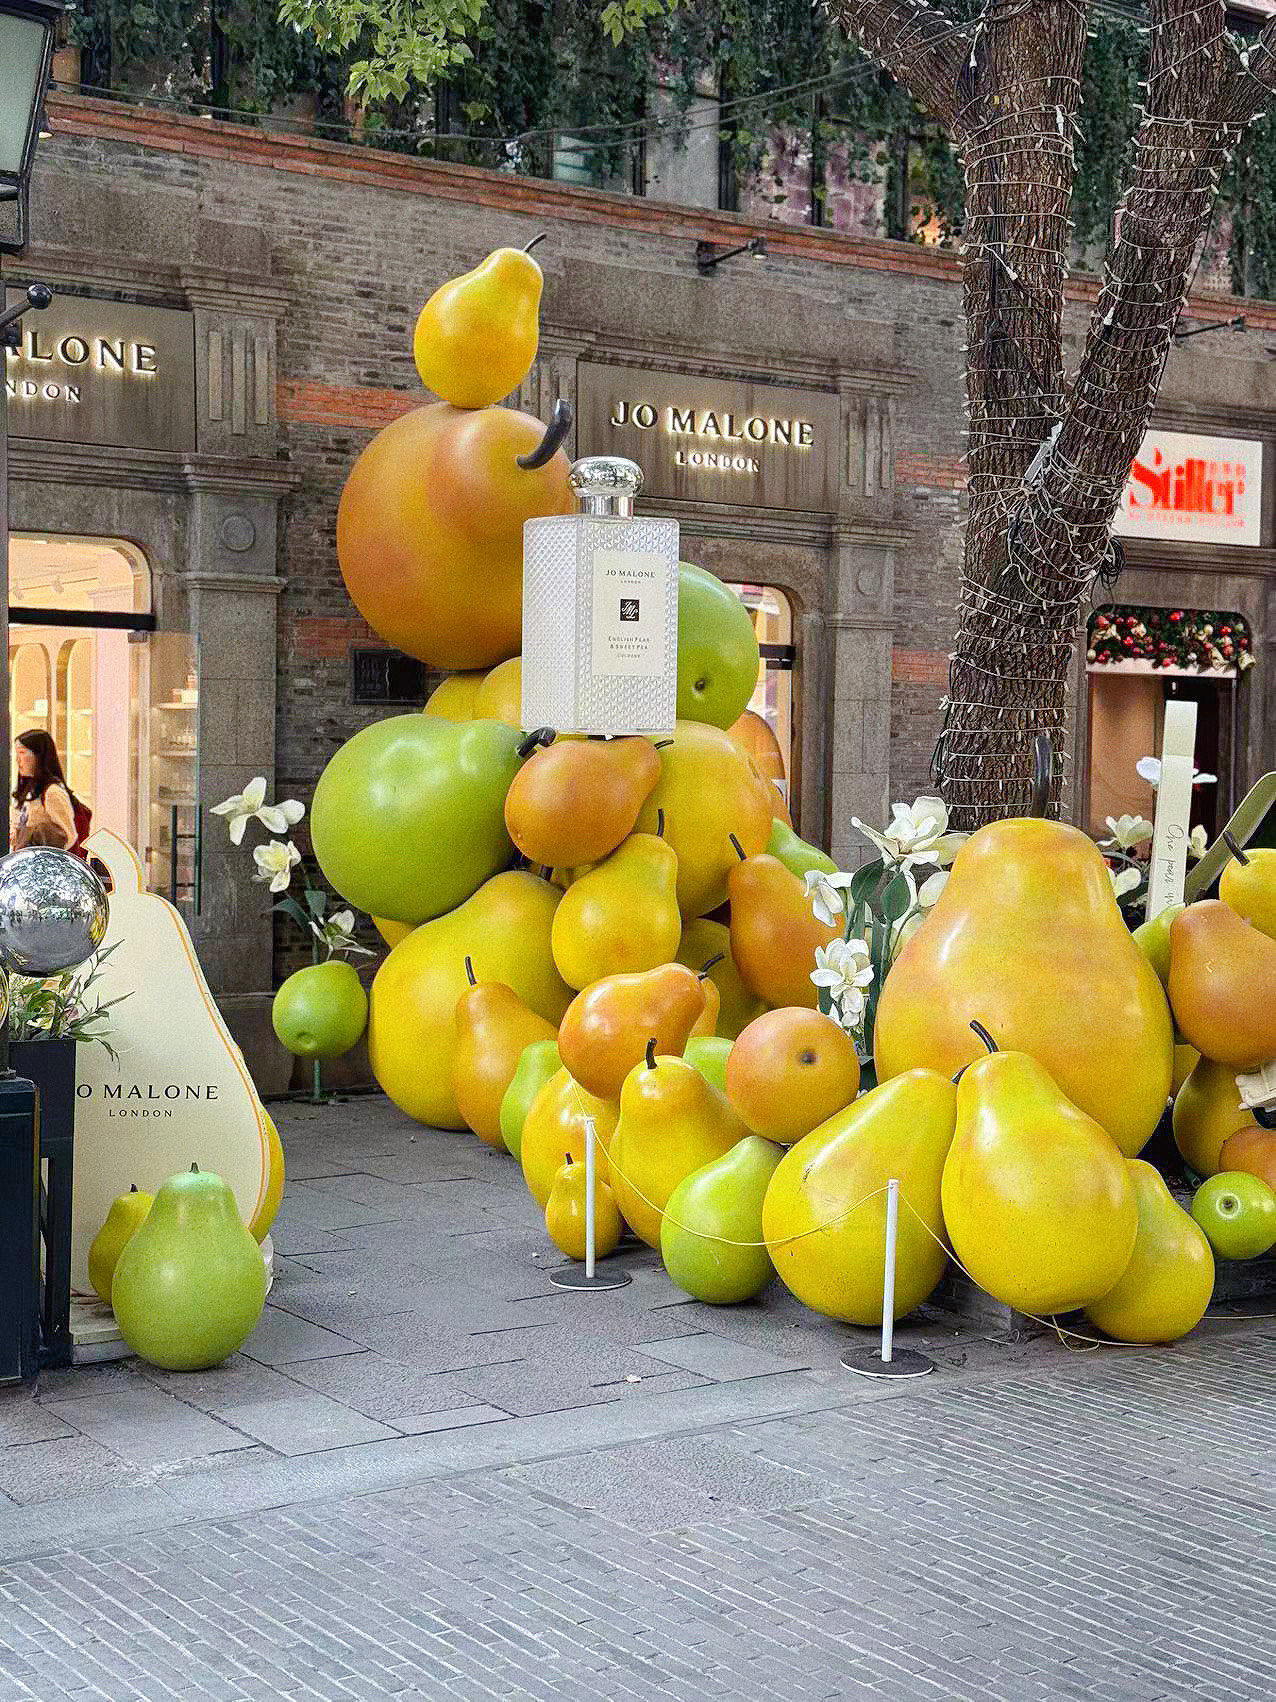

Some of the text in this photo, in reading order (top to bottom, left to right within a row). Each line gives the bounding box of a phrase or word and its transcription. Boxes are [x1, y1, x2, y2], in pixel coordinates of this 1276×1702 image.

[6, 331, 158, 374] LONE
[6, 380, 81, 402] NDON
[610, 401, 814, 447] JO MALONE
[676, 451, 761, 472] LONDON
[619, 570, 656, 578] MALONE
[1168, 824, 1185, 852] One
[76, 1084, 219, 1099] O MALONE
[109, 1109, 172, 1117] LONDON
